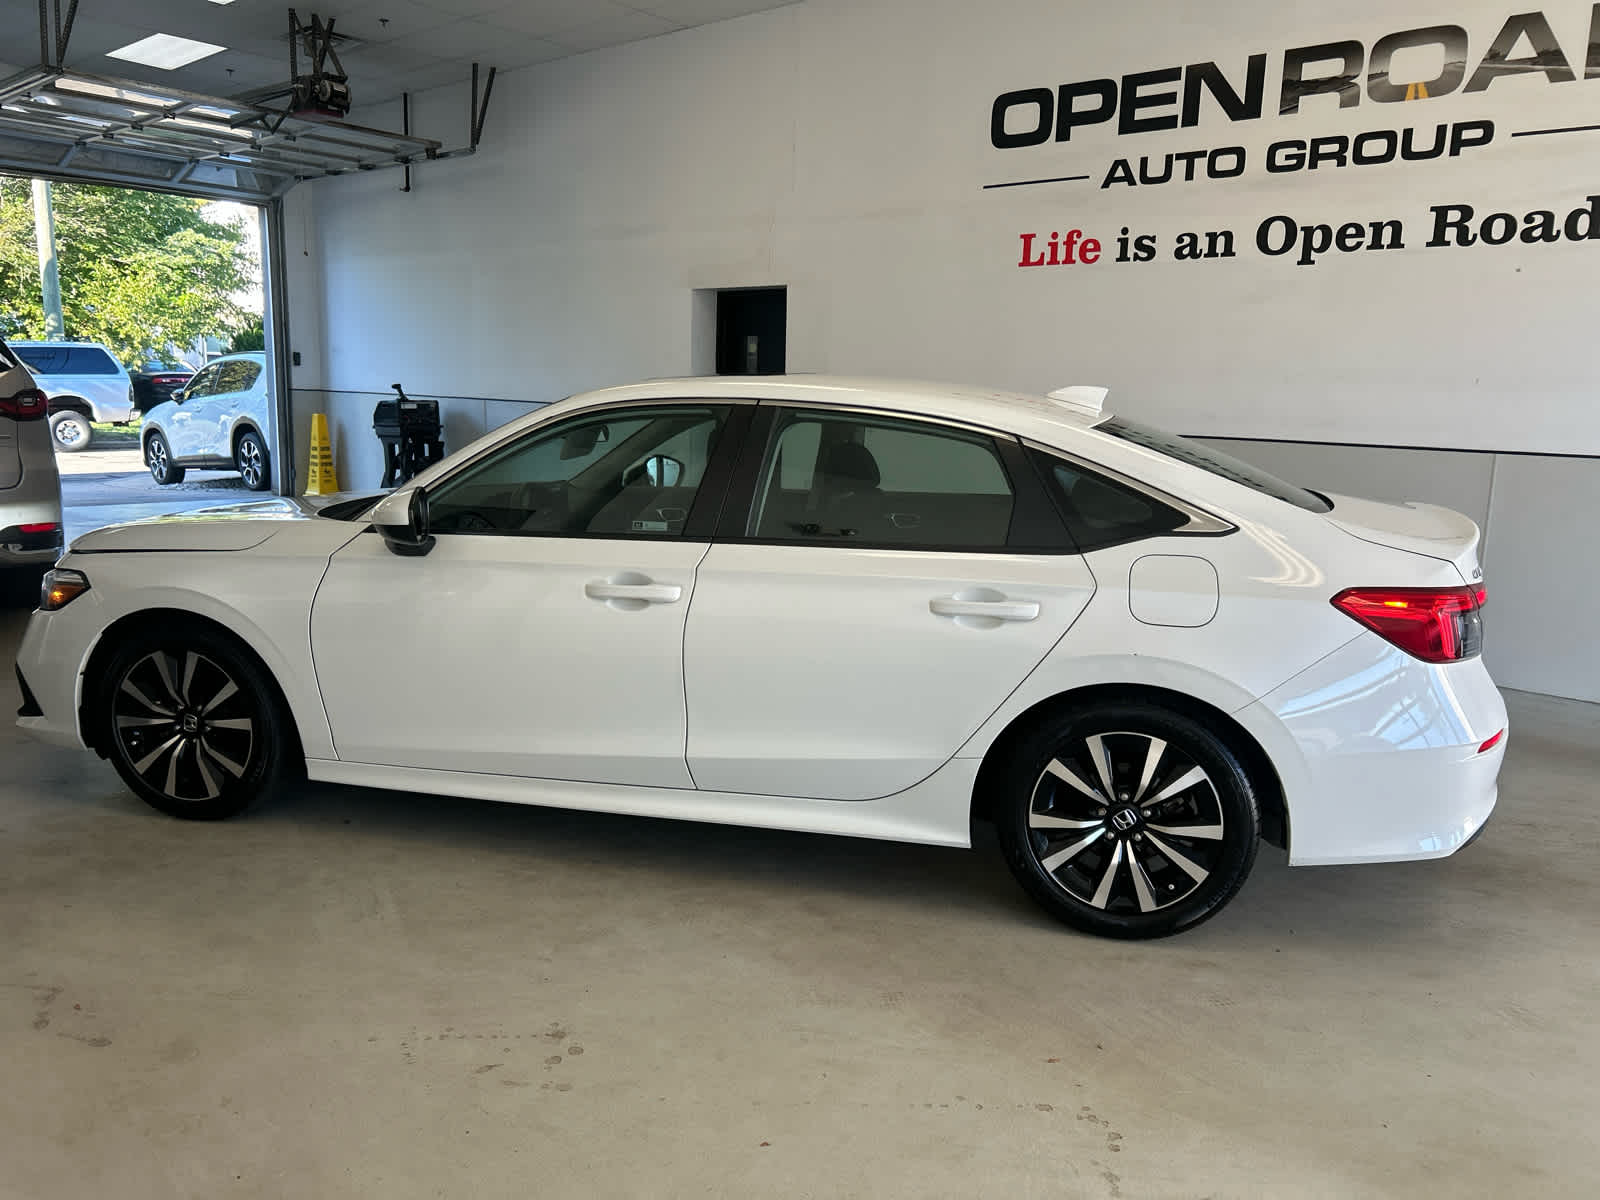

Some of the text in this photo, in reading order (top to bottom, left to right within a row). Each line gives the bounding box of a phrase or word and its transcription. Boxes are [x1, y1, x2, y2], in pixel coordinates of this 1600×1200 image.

[990, 2, 1600, 150] OPEN ROA
[1100, 119, 1495, 190] AUTO GROUP
[1017, 195, 1600, 268] Life is an Open Road
